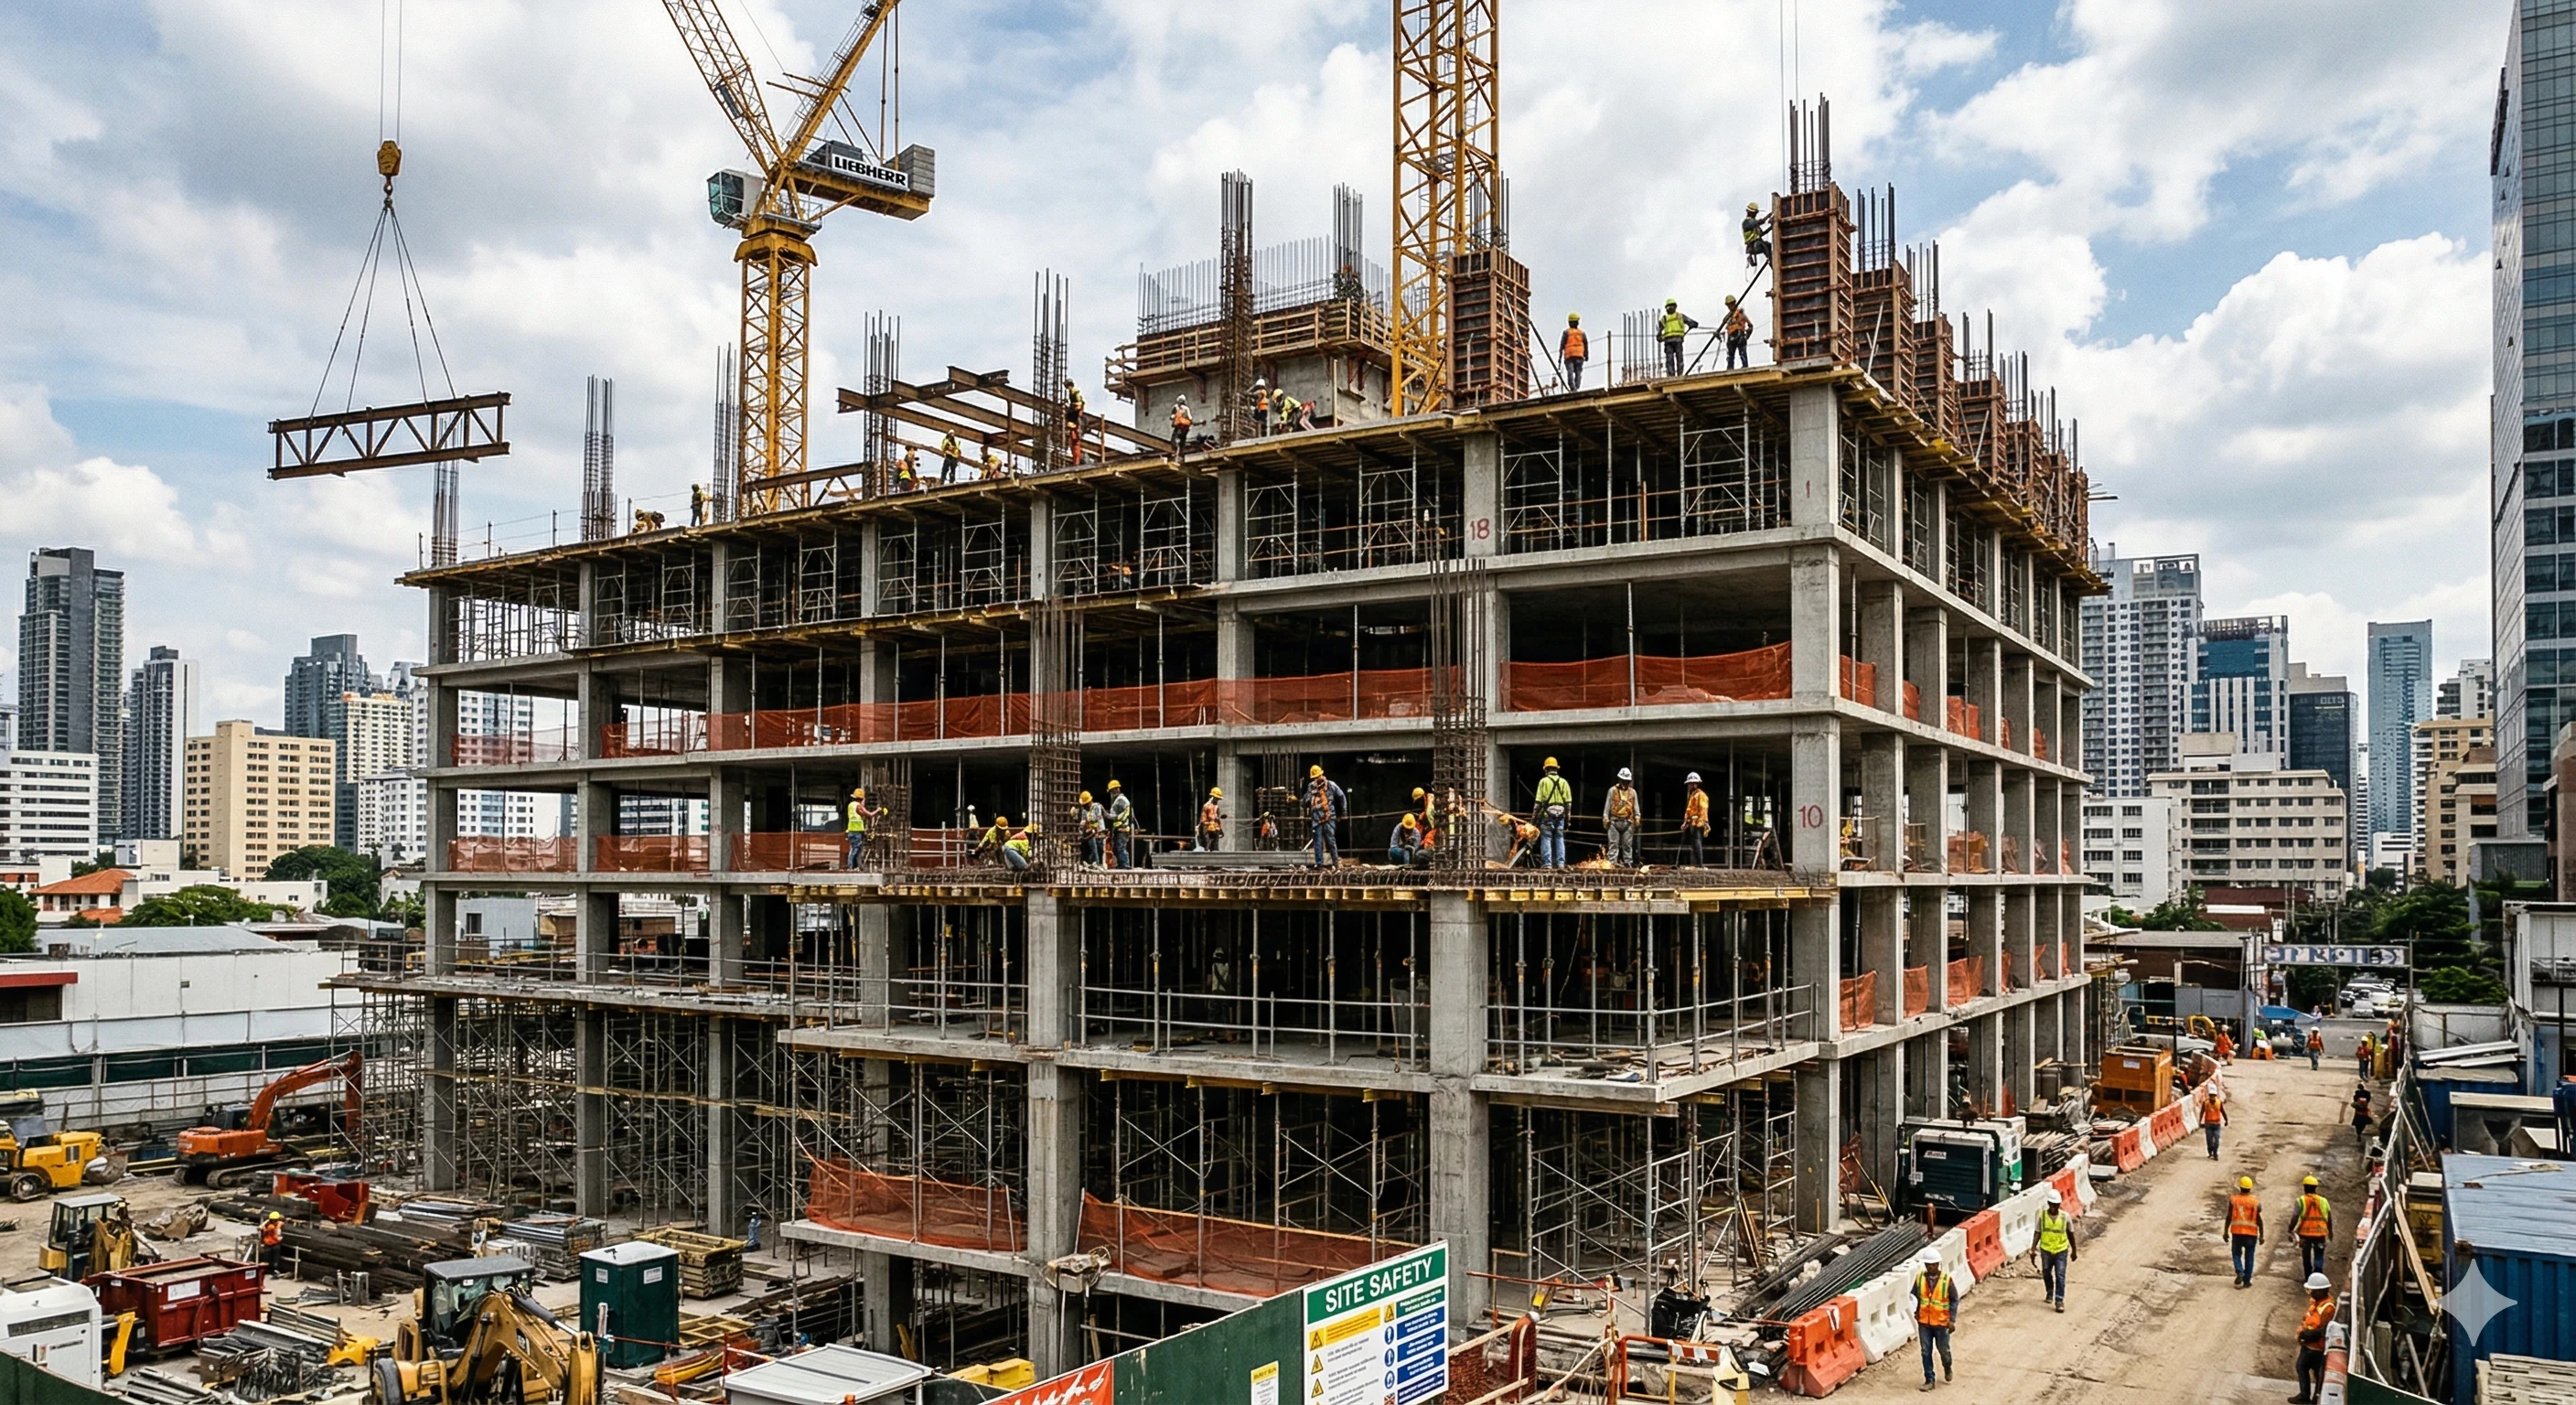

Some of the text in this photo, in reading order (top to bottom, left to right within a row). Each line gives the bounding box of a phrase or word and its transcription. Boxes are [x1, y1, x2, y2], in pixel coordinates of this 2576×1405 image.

[834, 156, 906, 186] LIEBHERR
[1470, 518, 1490, 541] 18
[1798, 805, 1823, 829] 10
[1326, 1279, 1365, 1313] SITE
[1369, 1257, 1433, 1298] SAFETY
